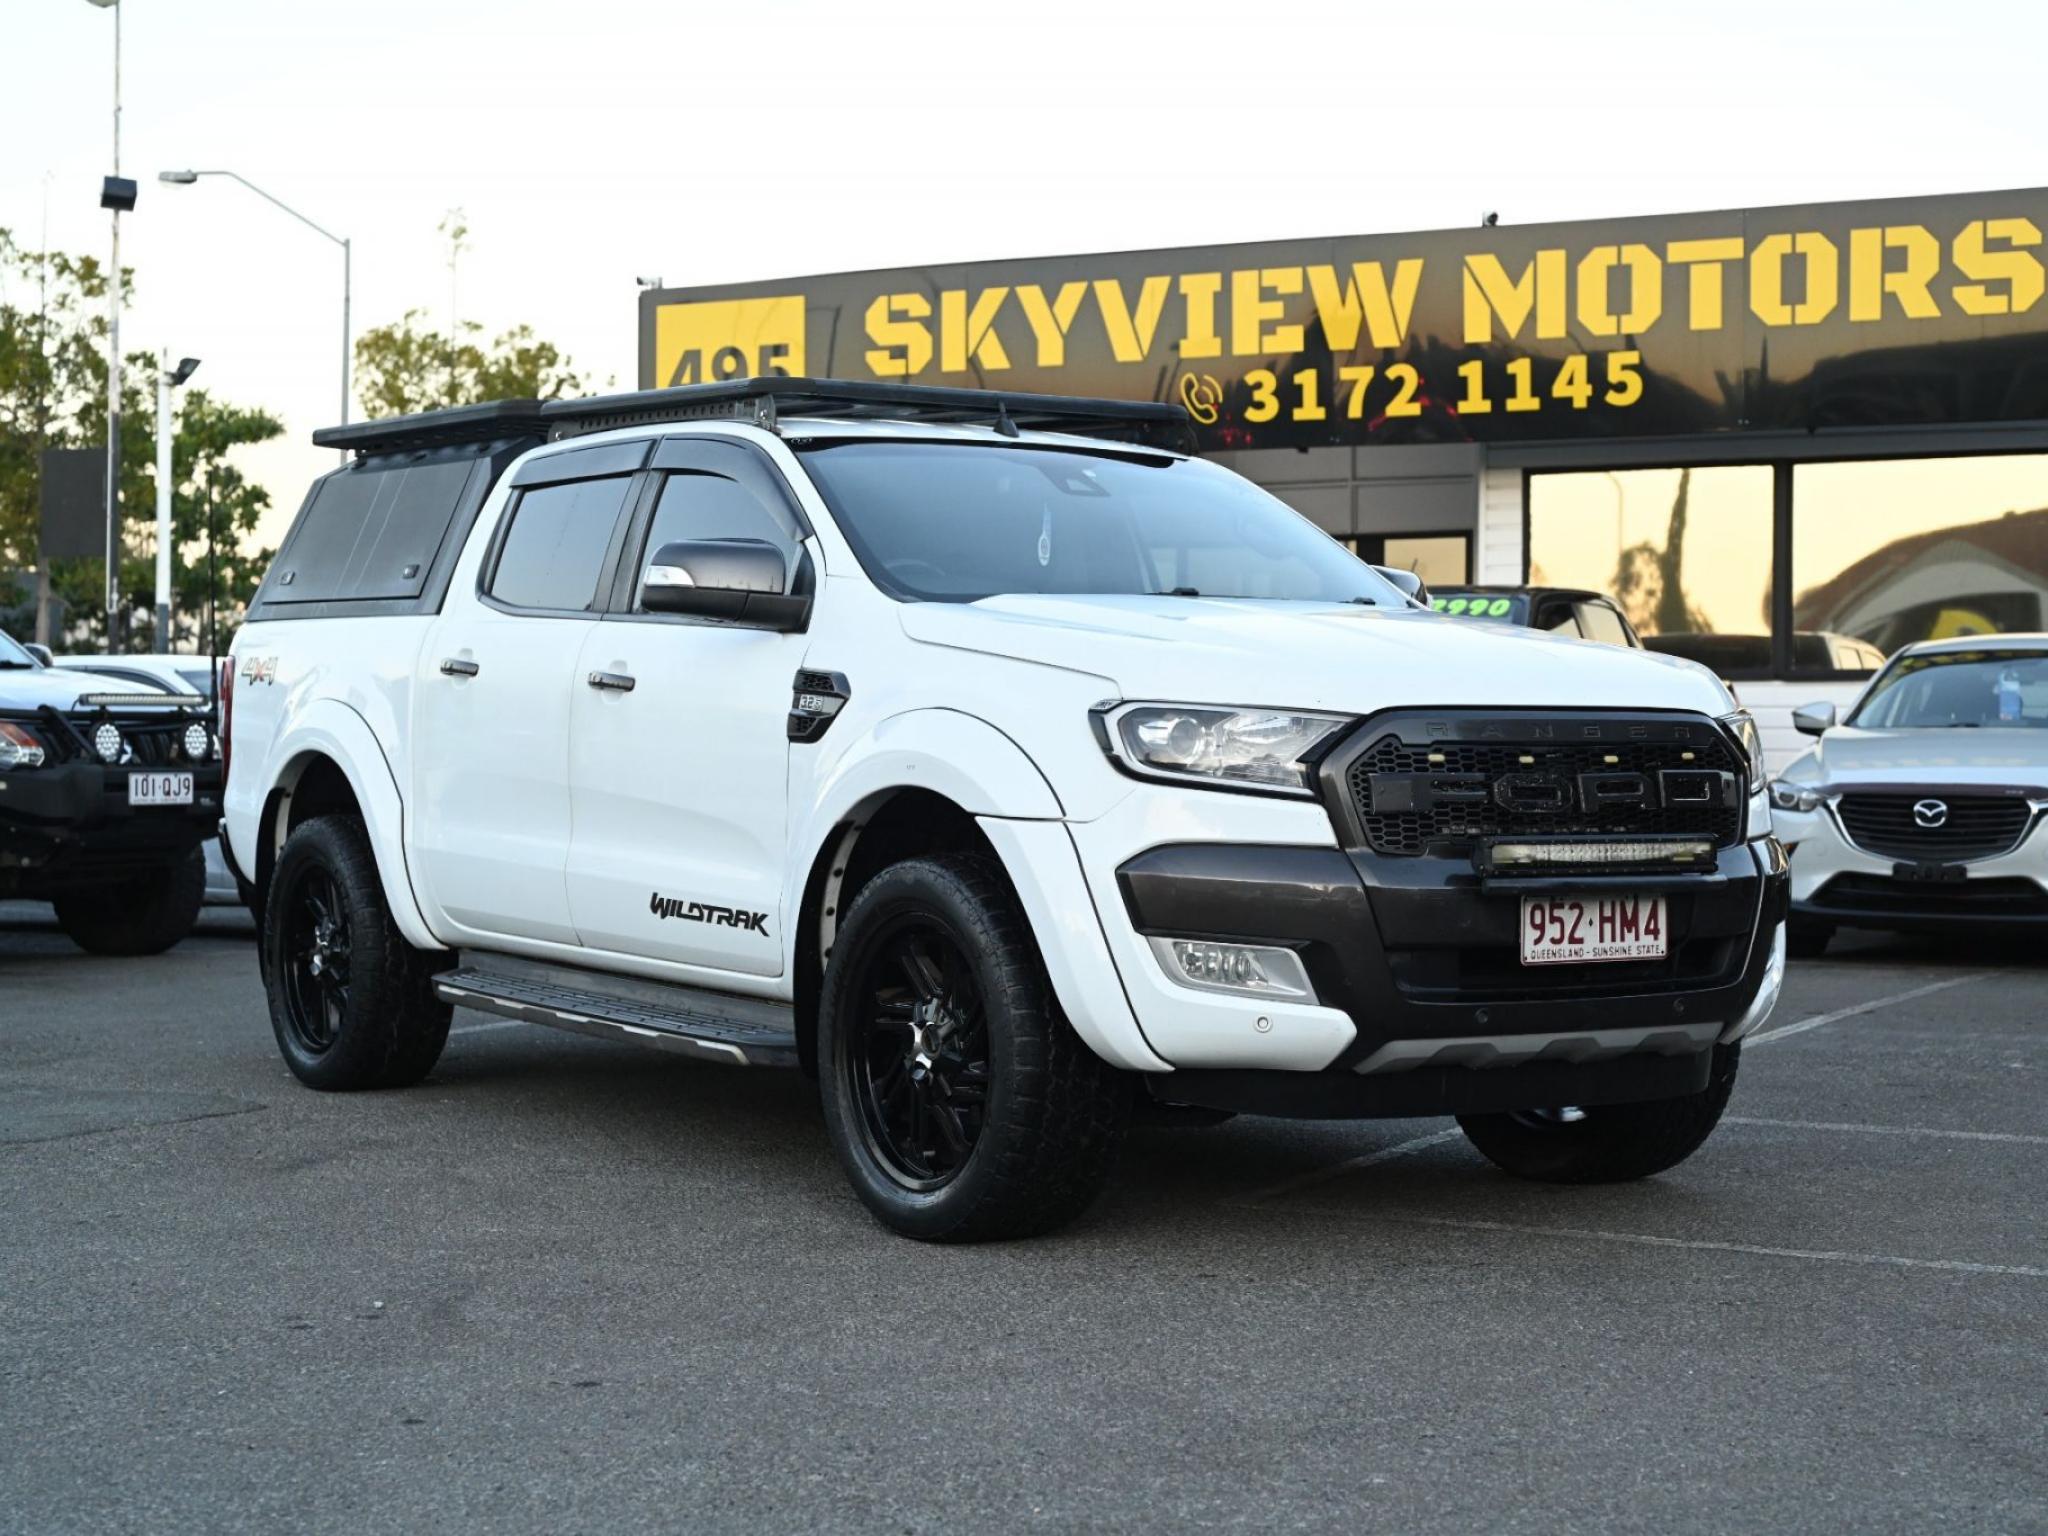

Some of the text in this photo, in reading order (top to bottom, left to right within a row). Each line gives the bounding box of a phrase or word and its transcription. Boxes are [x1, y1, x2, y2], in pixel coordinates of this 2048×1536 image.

[865, 217, 2045, 375] SKYVIEW MOTORS
[1244, 351, 1644, 423] 3172 1145
[1426, 721, 1691, 739] RANGER
[1369, 769, 1738, 815] FORD
[650, 892, 770, 937] WILDTRAK
[1531, 948, 1584, 960] QUEENSLAND
[1592, 946, 1632, 957] SUNSHINE
[1636, 944, 1660, 955] STATE
